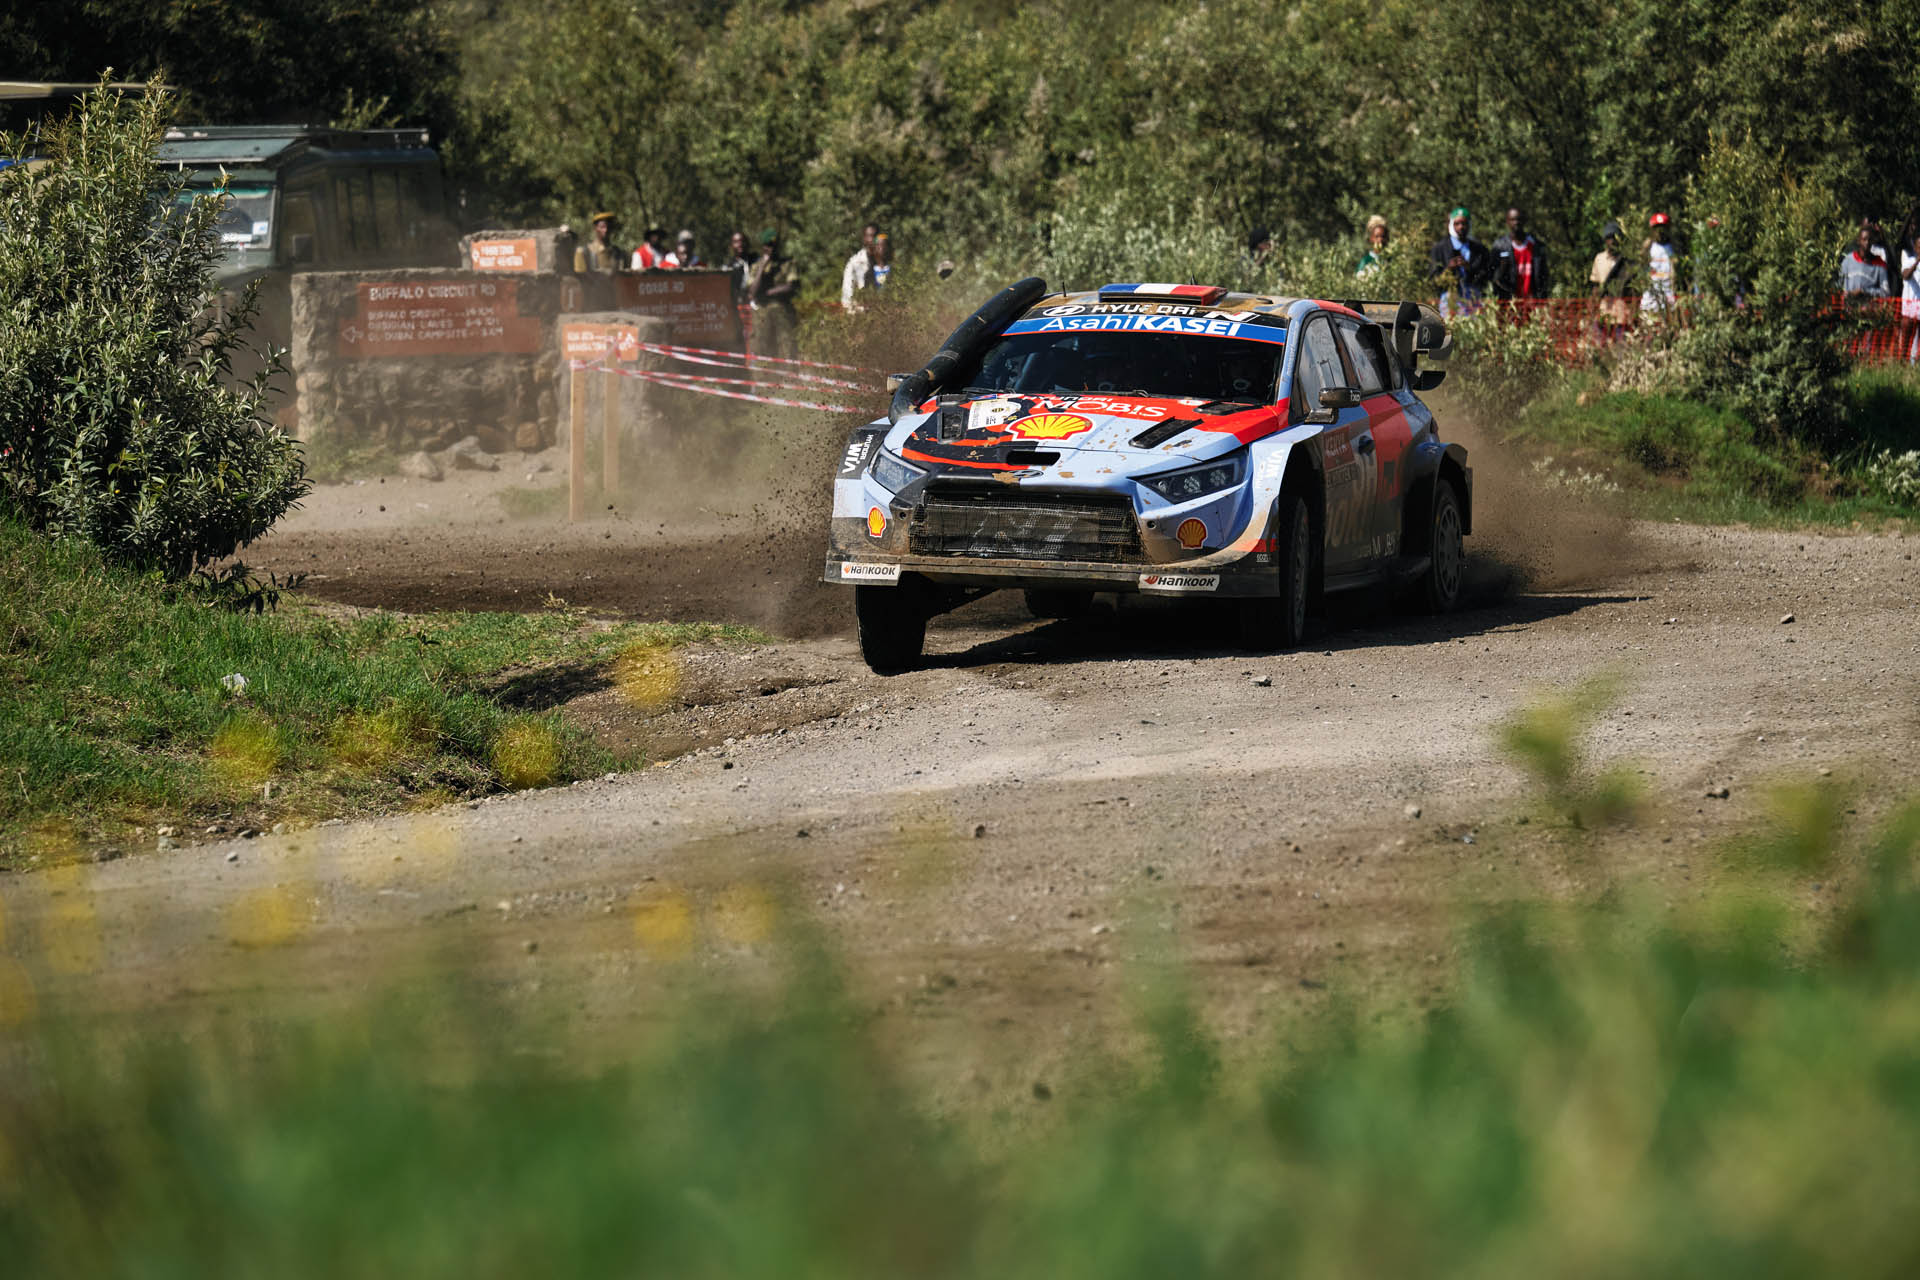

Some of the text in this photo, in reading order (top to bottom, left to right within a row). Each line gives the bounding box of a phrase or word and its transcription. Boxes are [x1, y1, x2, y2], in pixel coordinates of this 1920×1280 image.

[369, 284, 496, 301] BUFFALO CIRCUIT RD
[1033, 400, 1167, 417] MOBIS
[860, 434, 874, 461] HYUNDAI
